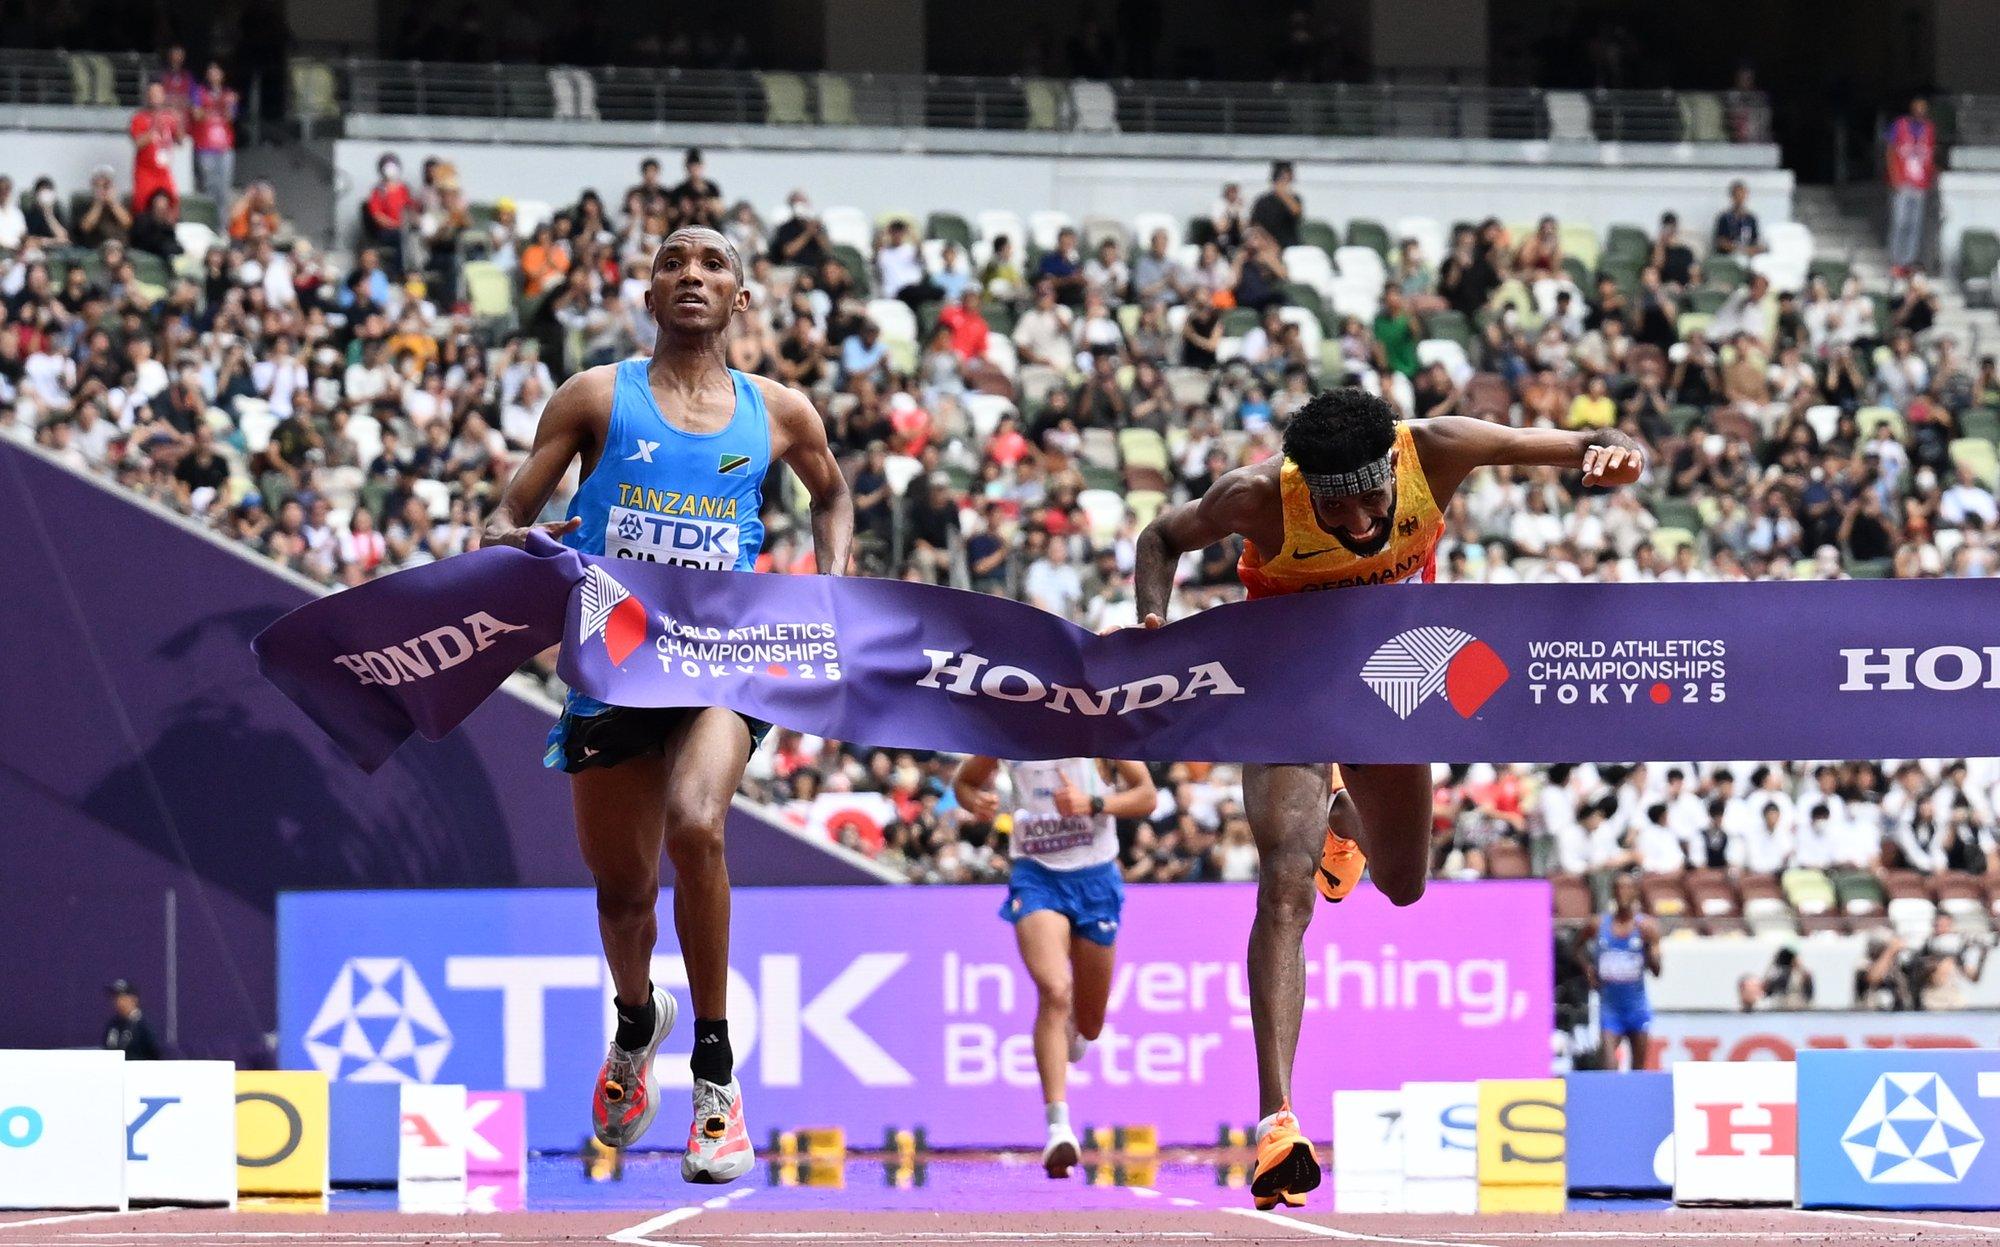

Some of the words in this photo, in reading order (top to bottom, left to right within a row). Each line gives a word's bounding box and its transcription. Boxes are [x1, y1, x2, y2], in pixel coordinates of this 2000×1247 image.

[618, 483, 738, 520] TANZANIA
[644, 516, 730, 553] TDK
[658, 615, 721, 640] WORLD
[727, 623, 836, 641] ATHLETICS
[333, 610, 530, 686] HONDA
[656, 635, 838, 663] CHAMPIONSHIPS
[1528, 641, 1606, 658] WORLD
[1611, 639, 1726, 658] ATHLETICS
[915, 649, 1245, 716] HONDA
[1528, 660, 1726, 681] CHAMPIONSHIPS
[943, 951, 1014, 1014] In
